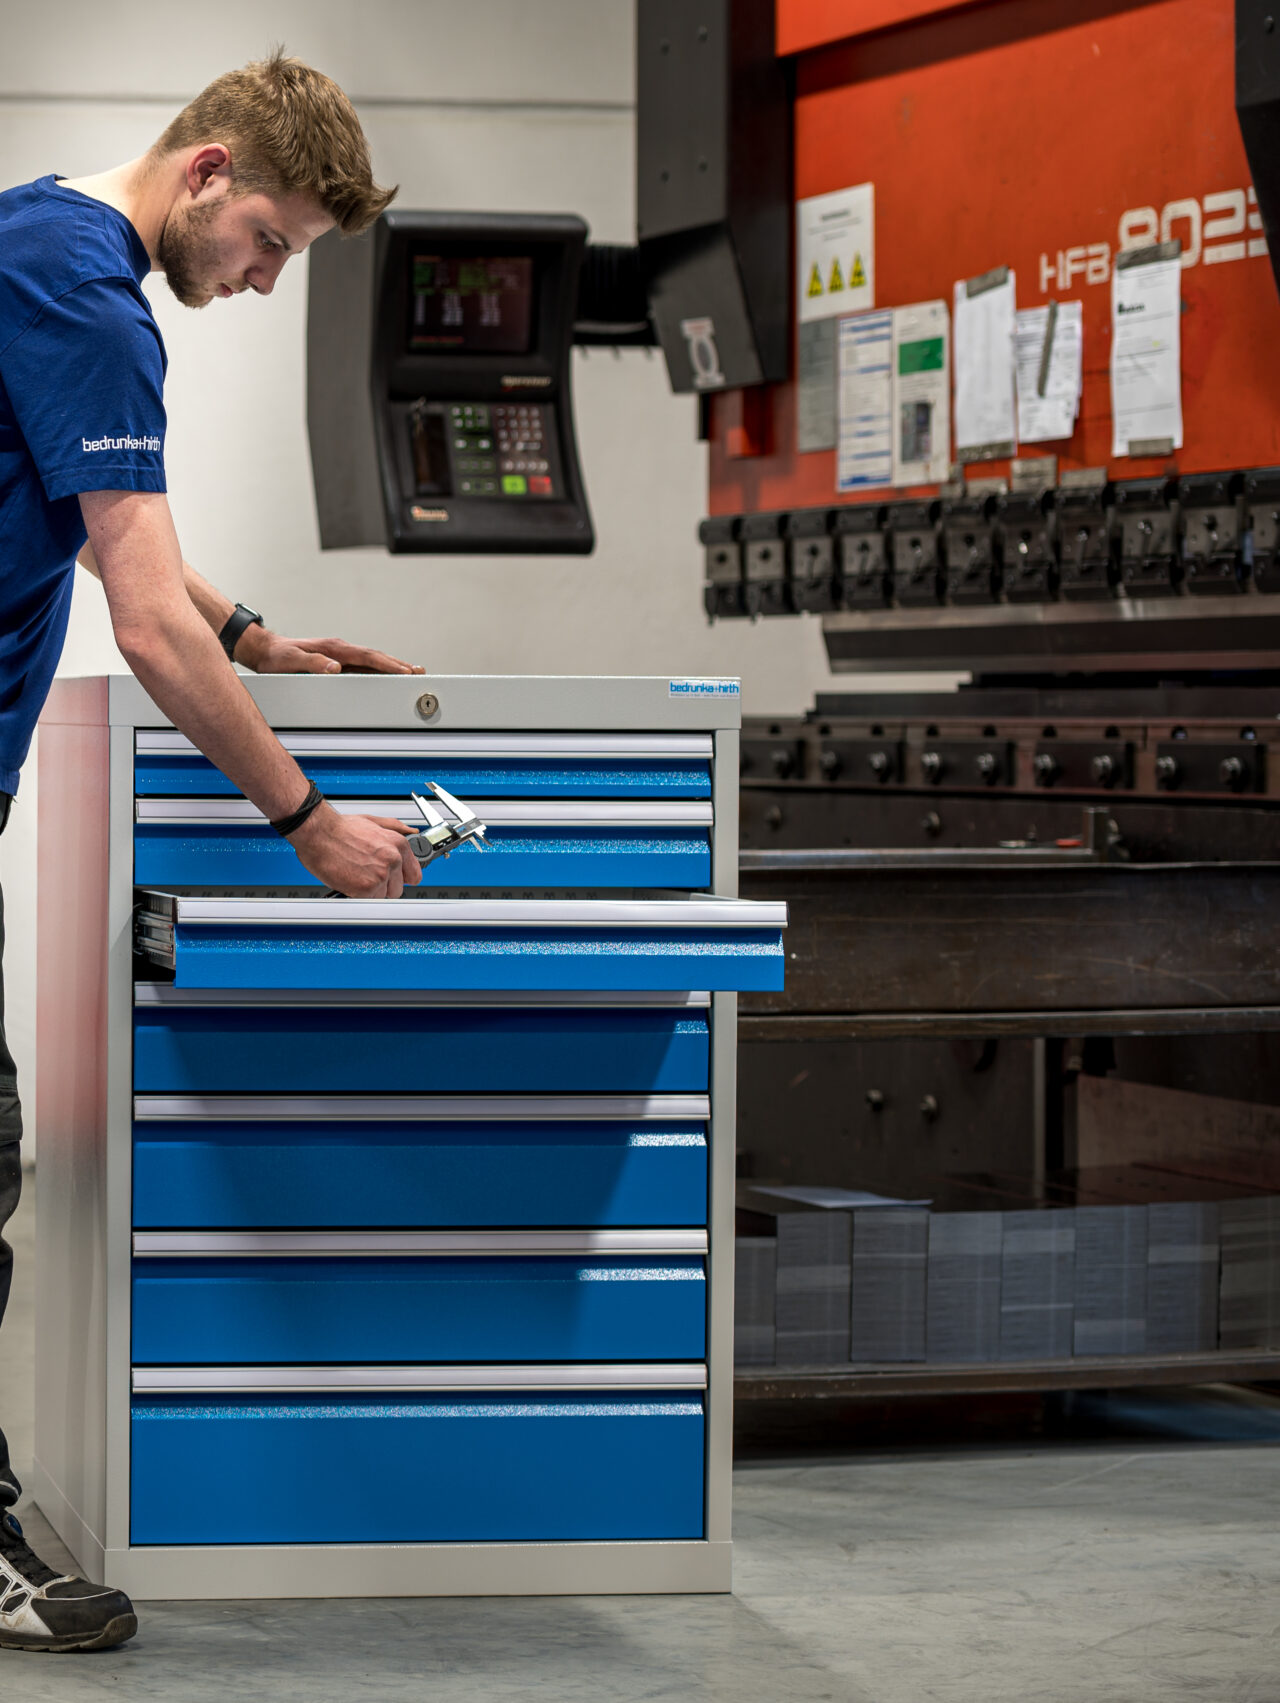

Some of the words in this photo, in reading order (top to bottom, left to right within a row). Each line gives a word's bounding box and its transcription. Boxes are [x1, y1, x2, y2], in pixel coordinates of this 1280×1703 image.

[1040, 242, 1110, 293] HFB
[82, 434, 161, 452] bedrunka+hirth
[670, 682, 739, 693] bedrunka+hirth
